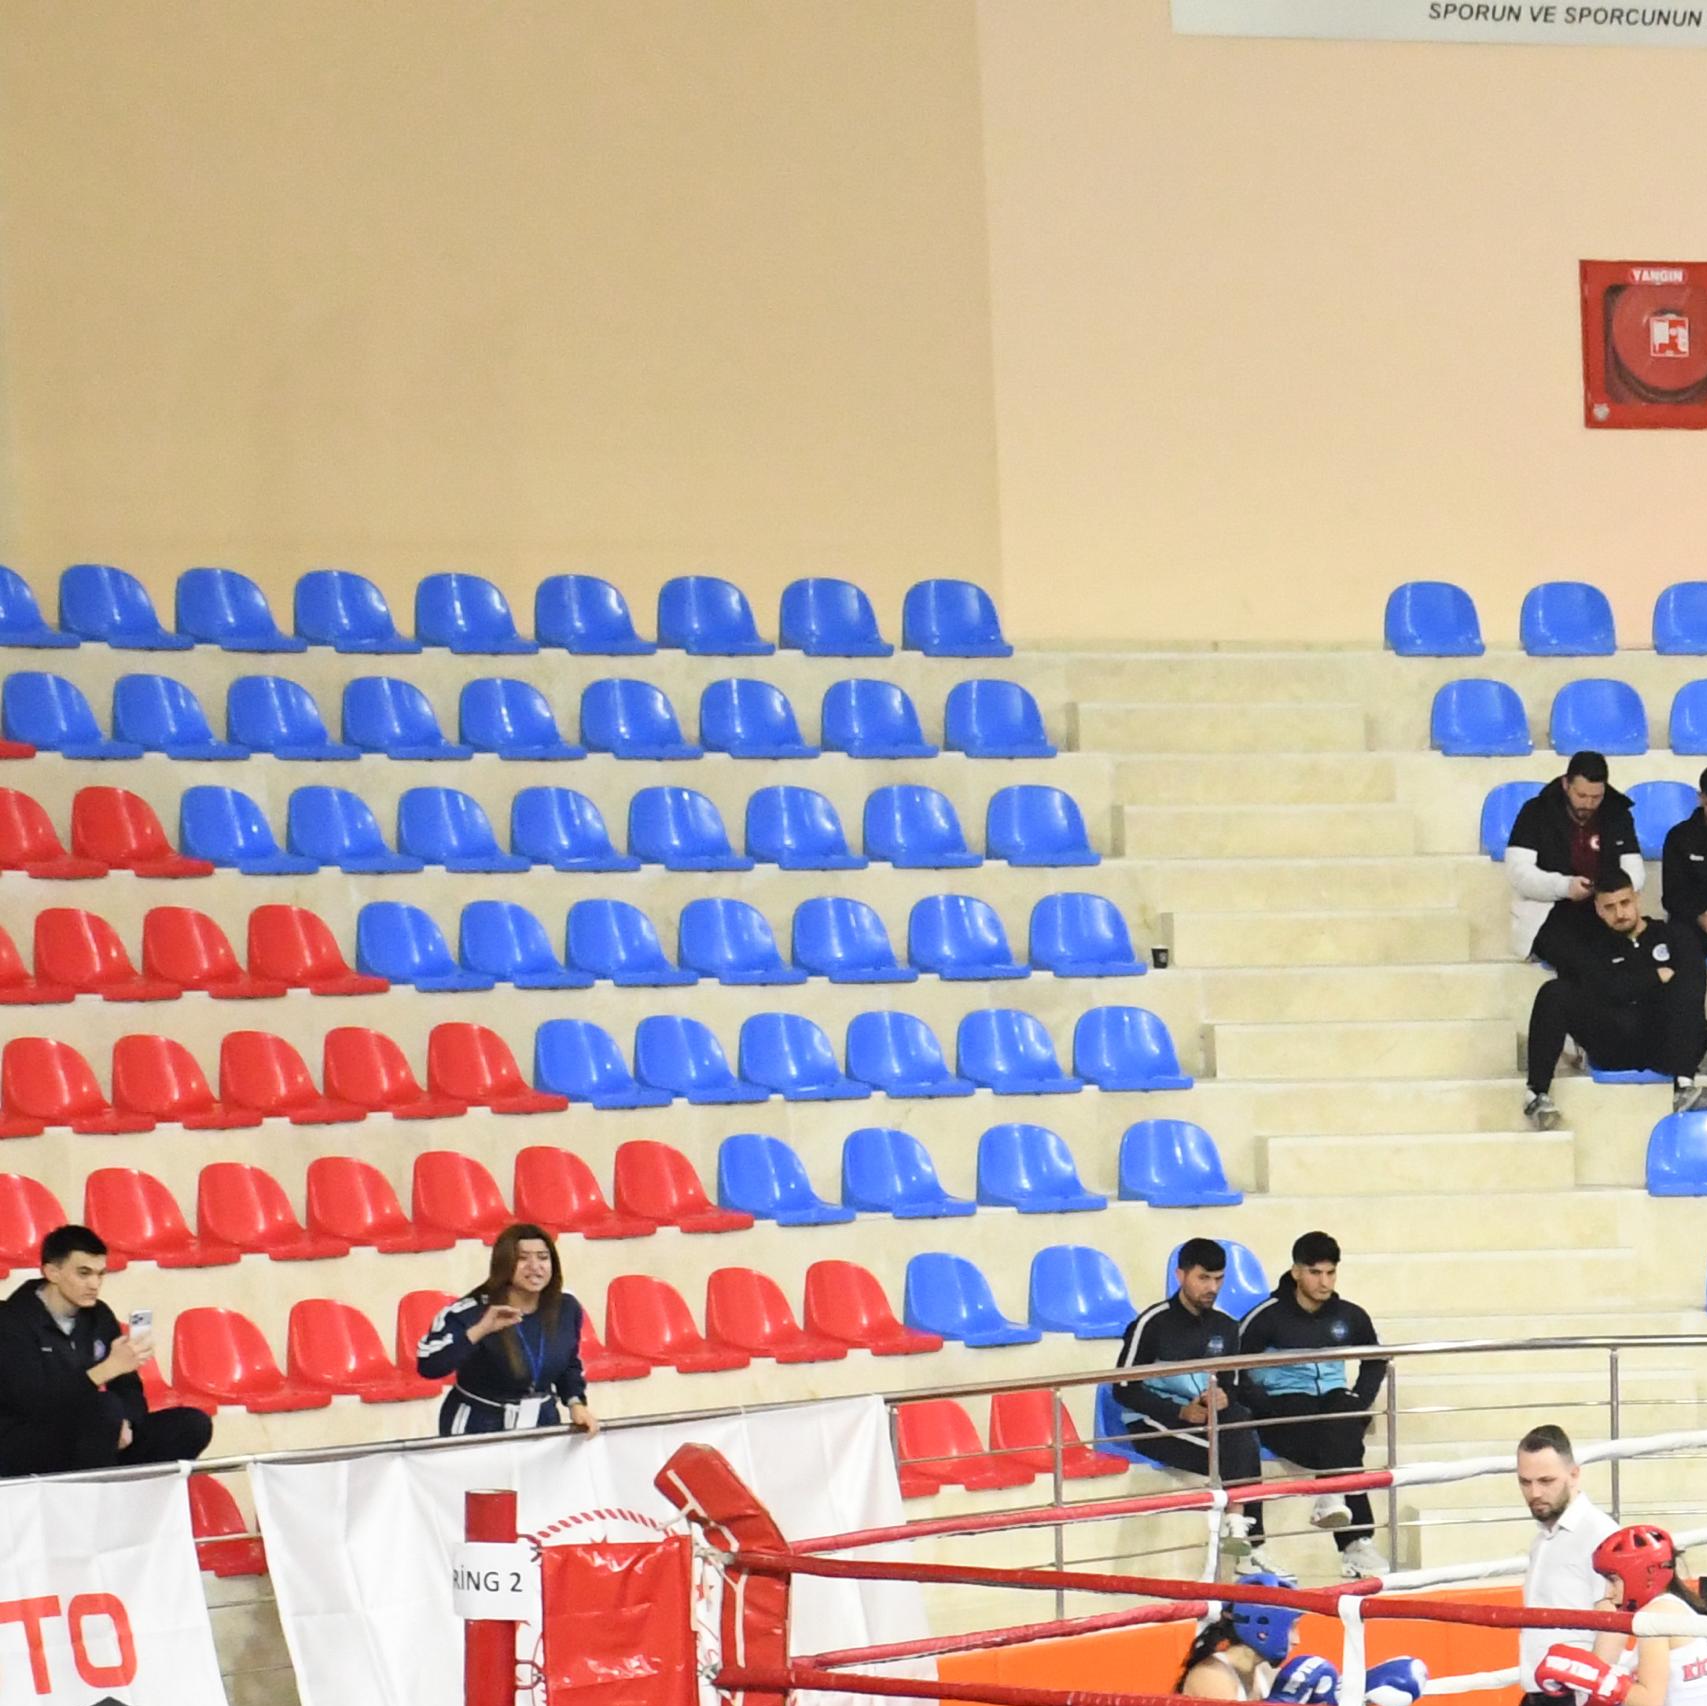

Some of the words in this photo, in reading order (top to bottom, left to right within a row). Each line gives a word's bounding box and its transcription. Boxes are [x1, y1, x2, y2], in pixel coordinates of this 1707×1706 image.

[1428, 2, 1521, 23] SPORUN
[1529, 5, 1556, 24] VE
[1564, 7, 1702, 27] SPORCUNUN
[1632, 269, 1684, 283] YANGIN
[453, 1564, 499, 1592] RİNG
[509, 1571, 523, 1592] 2
